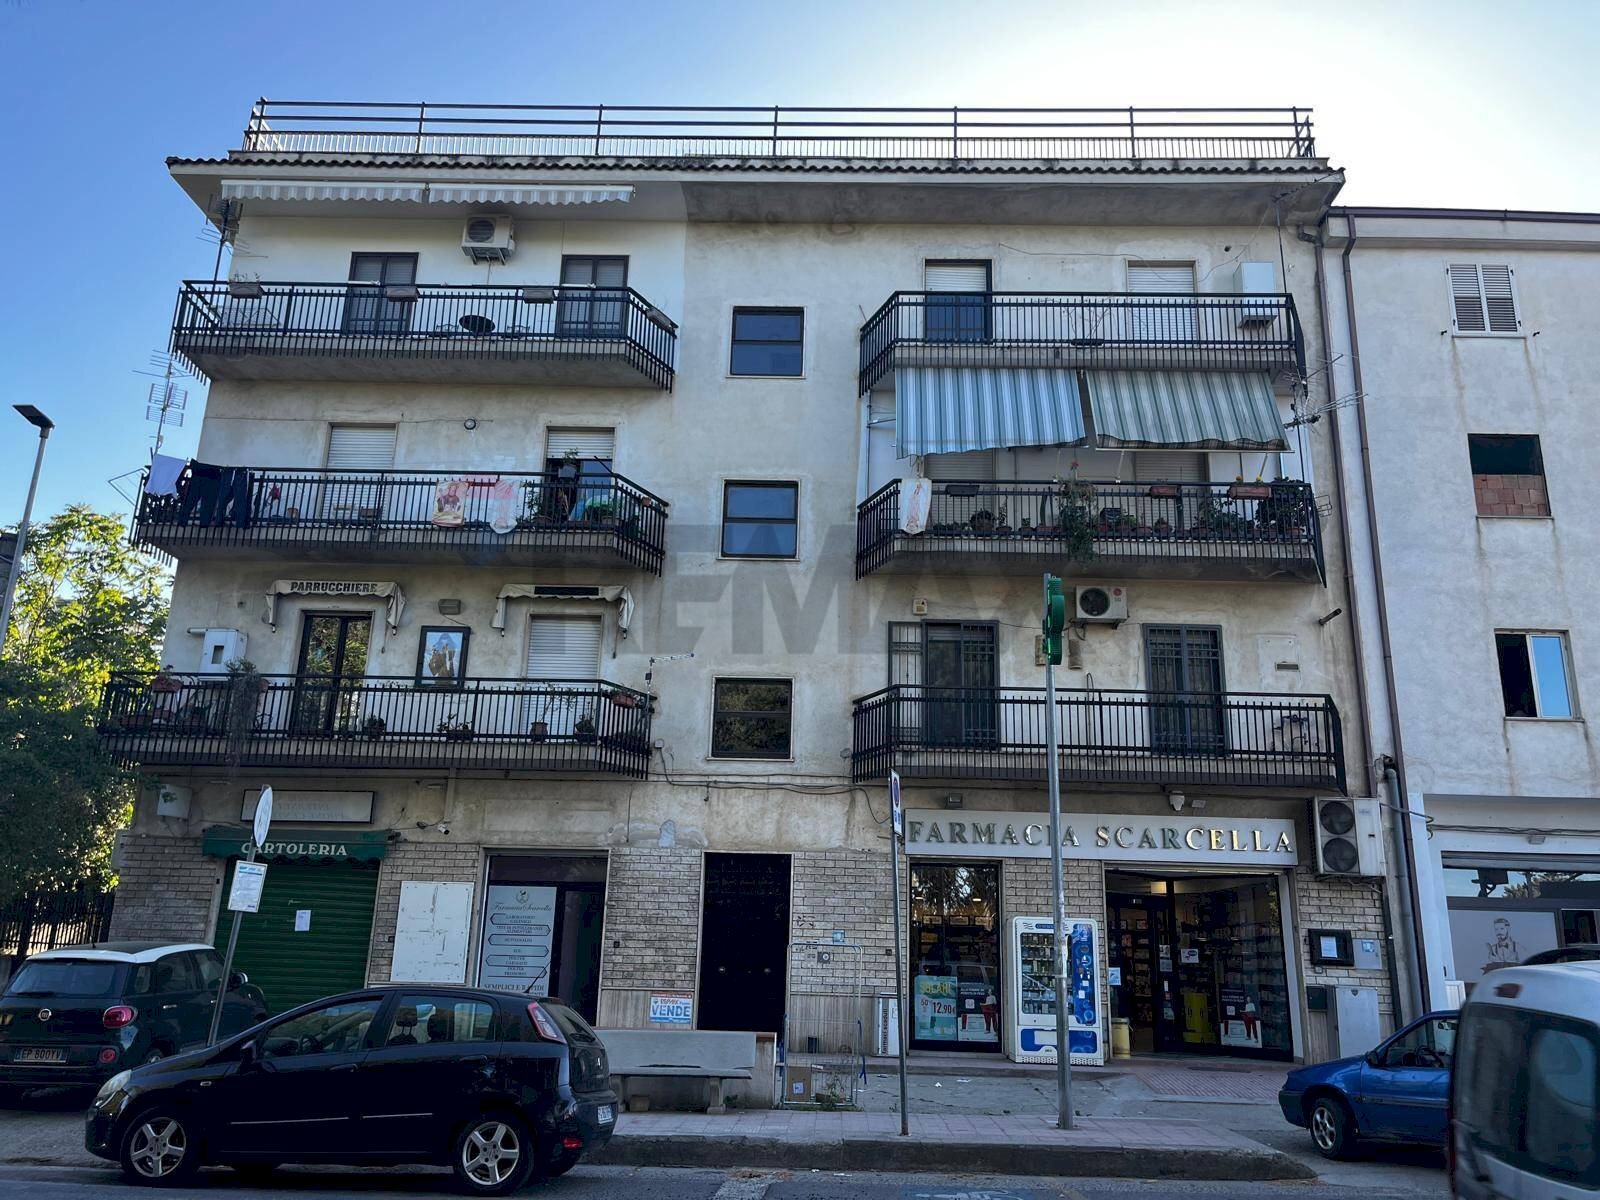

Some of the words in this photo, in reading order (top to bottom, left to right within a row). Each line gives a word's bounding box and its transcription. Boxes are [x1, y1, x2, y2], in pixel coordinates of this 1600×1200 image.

[290, 581, 378, 593] PARRUCCHIERE
[908, 820, 1080, 847] FARMACA
[1096, 826, 1294, 852] SCARCELLA
[652, 1004, 690, 1017] VENDE
